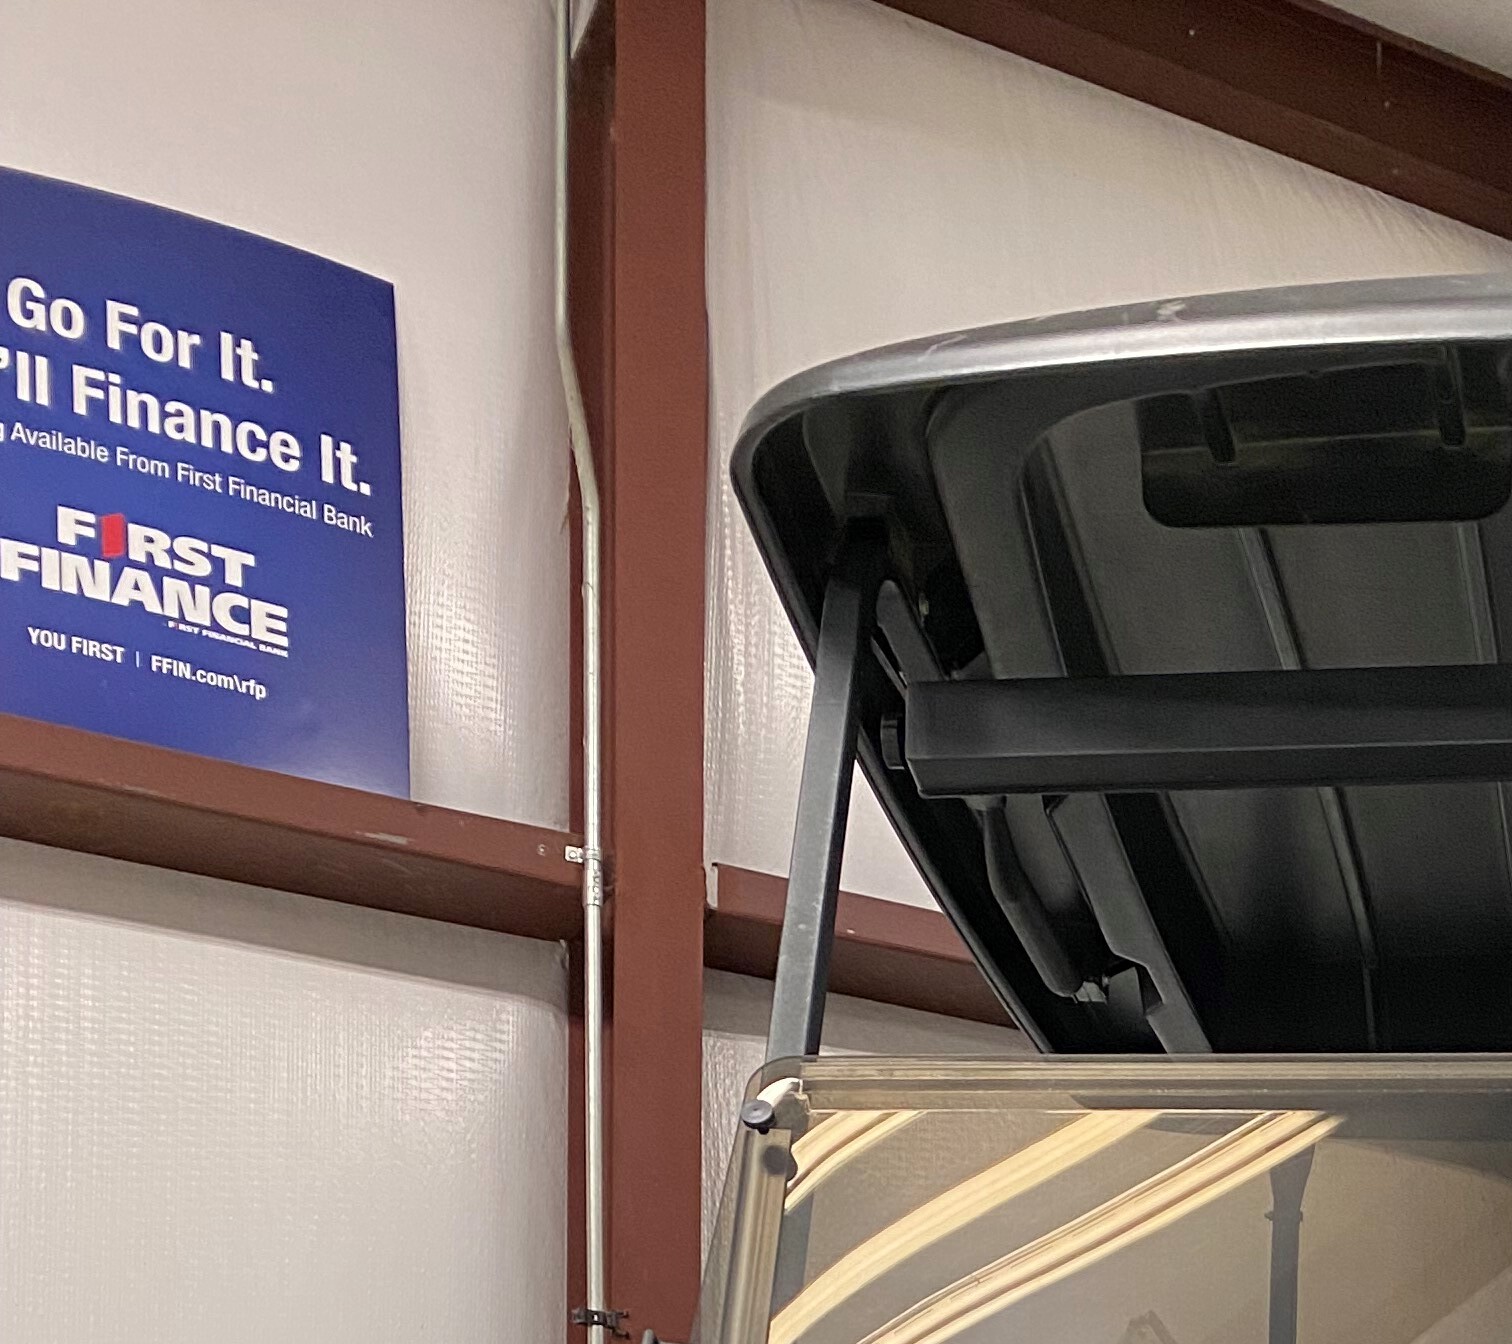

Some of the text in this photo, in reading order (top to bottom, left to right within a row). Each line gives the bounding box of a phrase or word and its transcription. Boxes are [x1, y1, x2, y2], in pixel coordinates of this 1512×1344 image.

[7, 276, 274, 394] Go For It.
[11, 422, 109, 463] Available
[116, 446, 170, 479] From
[176, 462, 223, 494] First
[228, 476, 317, 520] Financial
[323, 503, 375, 538] Bank
[72, 364, 301, 473] Finance
[320, 433, 371, 497] It.
[0, 537, 290, 648] FINANCE
[56, 504, 256, 588] FIRST
[27, 626, 268, 701] YOU FIRST FFIN.com\rfp
